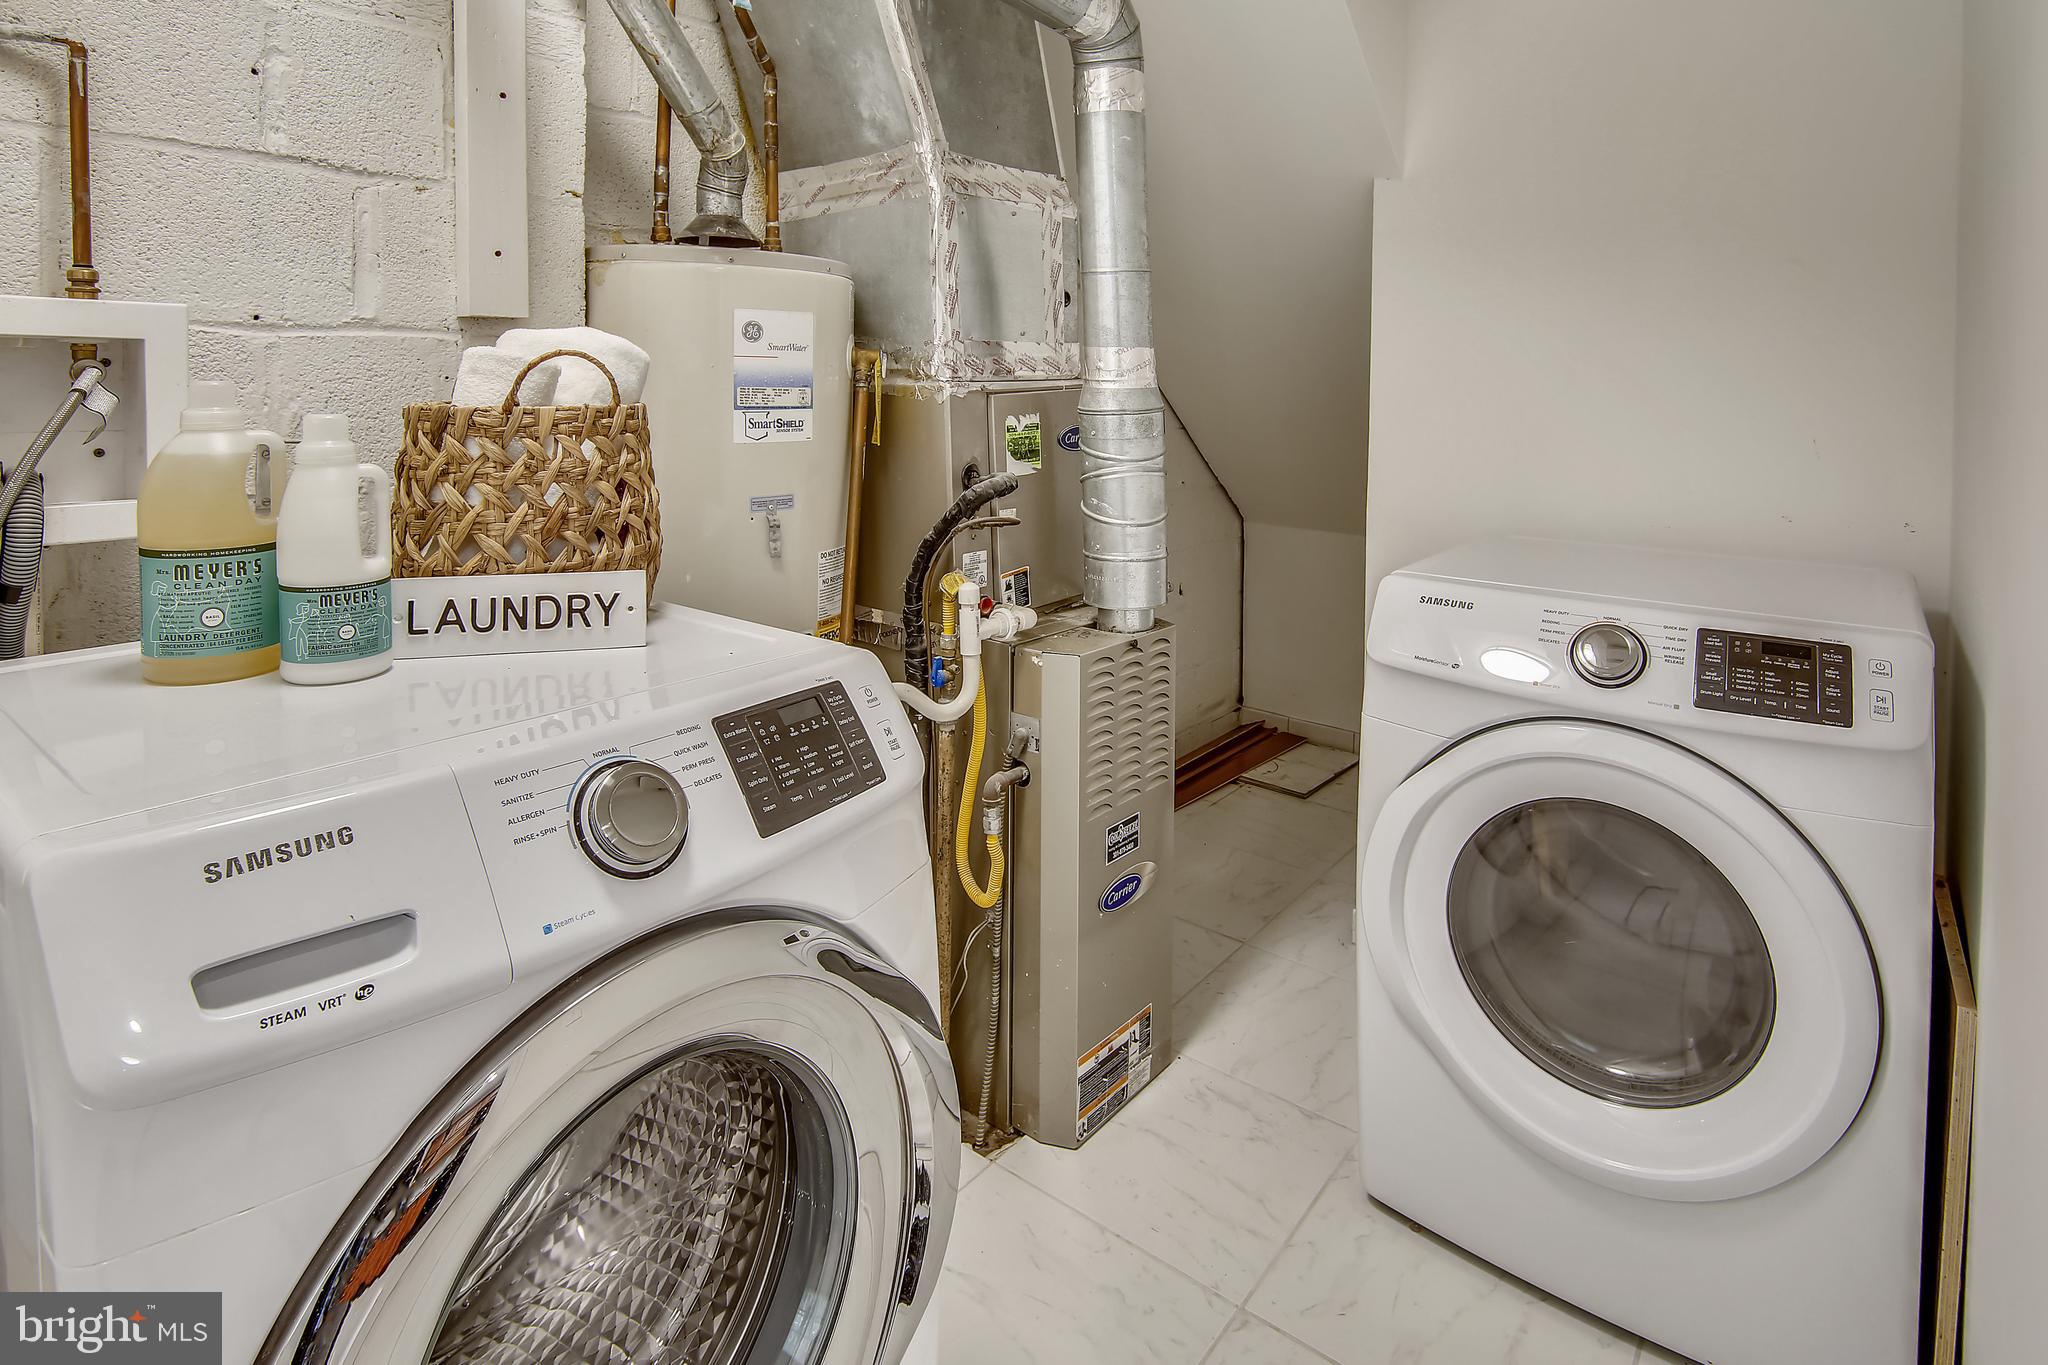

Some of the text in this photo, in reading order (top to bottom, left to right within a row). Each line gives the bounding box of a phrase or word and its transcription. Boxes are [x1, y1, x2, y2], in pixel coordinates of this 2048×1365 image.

[210, 548, 256, 556] HOMEKEEPING
[173, 558, 263, 581] MEYER'S
[173, 576, 262, 590] CLEAN DAY
[319, 589, 378, 607] MEYER'S
[1419, 595, 1474, 610] SAMSUNG
[407, 593, 621, 635] LAUNDRY
[158, 627, 260, 642] LAUNDRY DETERGENT
[246, 634, 263, 642] BOTTLE
[1664, 659, 1685, 667] RELEASE
[675, 724, 701, 736] BEDDING
[723, 730, 737, 738] Extra
[592, 746, 620, 759] NORMAL
[673, 740, 709, 757] QUICK WASH
[681, 757, 715, 772] PERM PRESS
[736, 751, 758, 763] Extra Spin
[494, 769, 540, 787] HEAVY DUTY
[693, 773, 723, 788] DELICATES
[747, 775, 769, 788] Spin Only
[501, 792, 534, 807] SANITIZE
[507, 808, 546, 826] ALLERGEN
[203, 826, 354, 884] SAMSUNG
[1107, 880, 1138, 905] Carrier
[553, 916, 574, 930] Steam
[259, 1006, 307, 1029] STEAM
